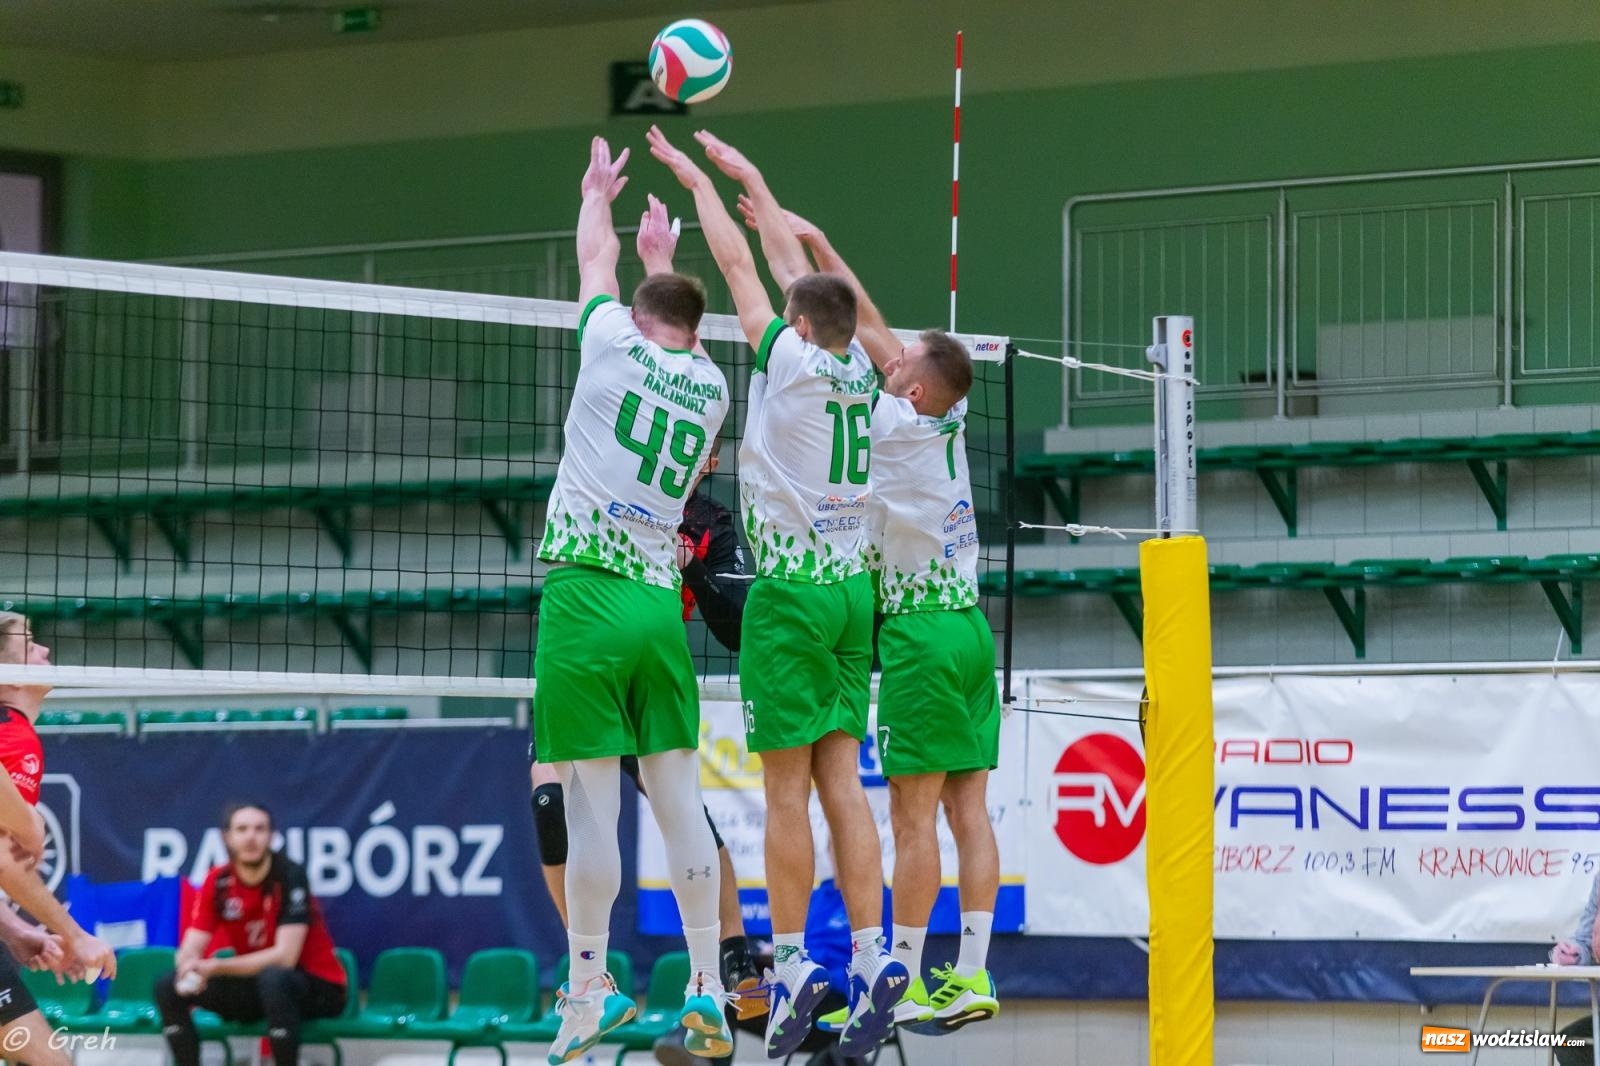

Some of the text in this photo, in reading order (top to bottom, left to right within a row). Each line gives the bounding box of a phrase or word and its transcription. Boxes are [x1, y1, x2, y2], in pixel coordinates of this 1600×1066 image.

[624, 79, 679, 110] A
[975, 342, 1000, 352] netex
[614, 390, 706, 499] 49
[825, 400, 871, 485] 16
[939, 421, 960, 481] 7
[879, 725, 892, 757] 7
[1214, 739, 1353, 764] ADIO
[141, 801, 505, 898] RAIBÓRZ
[1214, 846, 1295, 874] IBÓRZ
[1304, 851, 1355, 875] 100,3
[1361, 847, 1396, 877] FM
[1418, 846, 1570, 879] KRAPKOWICE
